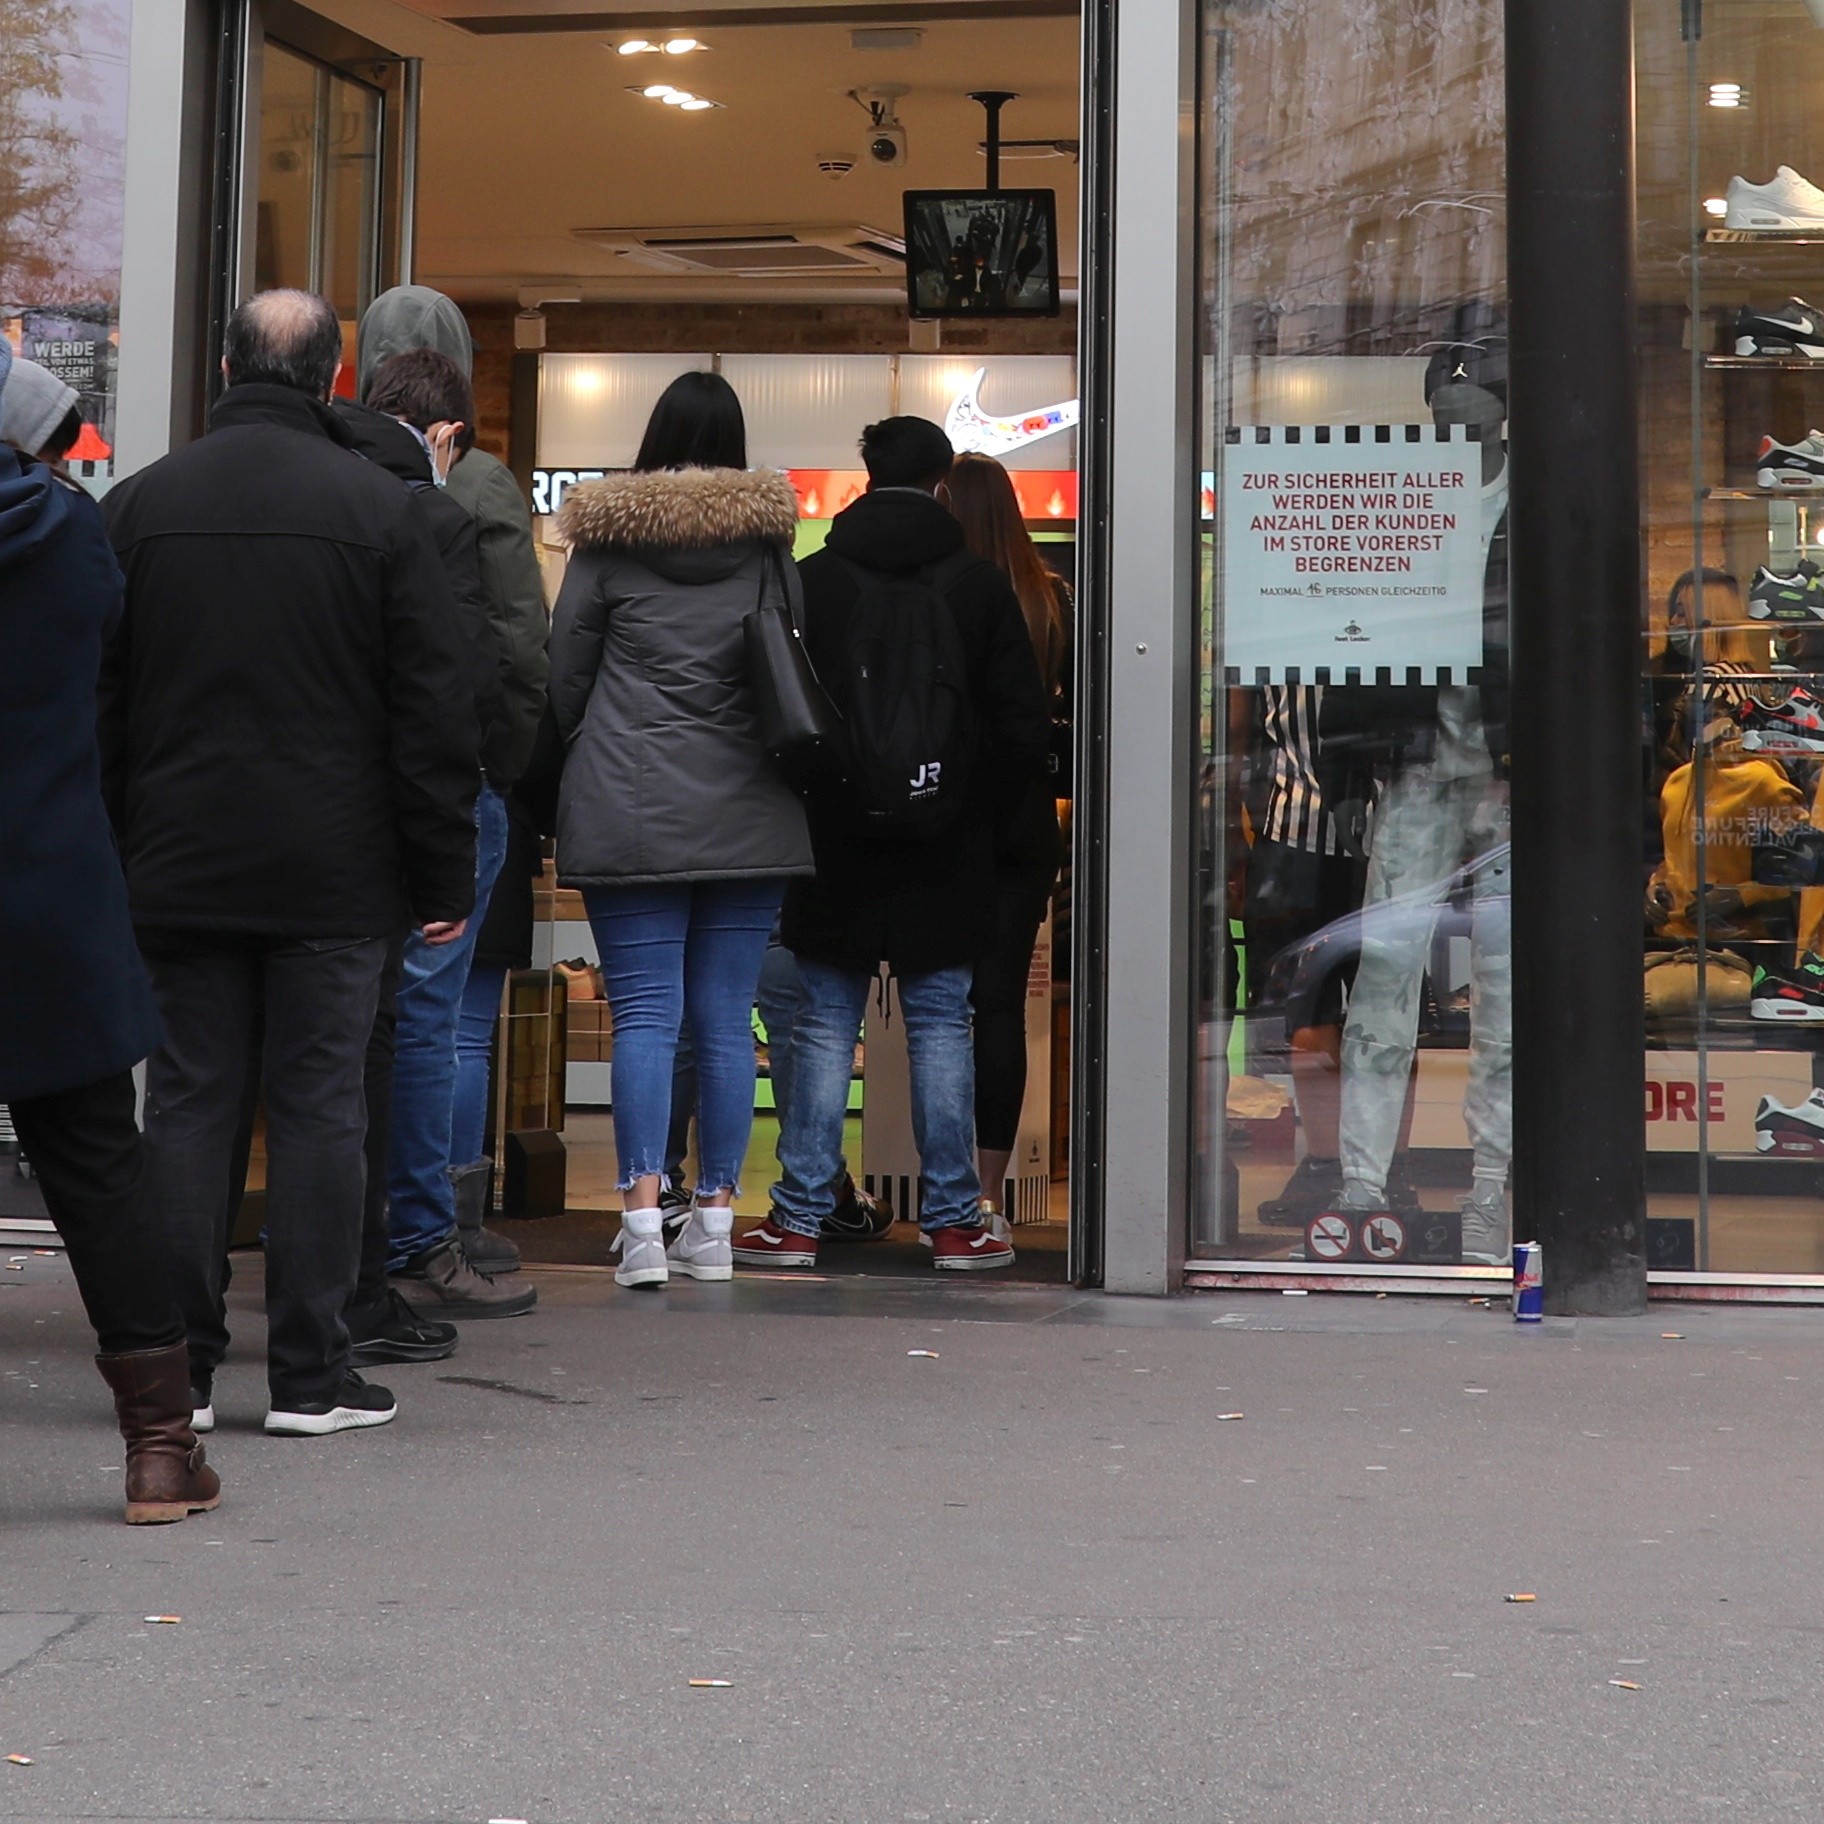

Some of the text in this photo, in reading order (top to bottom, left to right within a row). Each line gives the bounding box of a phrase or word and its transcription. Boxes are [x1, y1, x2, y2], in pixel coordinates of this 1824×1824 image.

[34, 341, 95, 357] WERDE
[49, 366, 94, 378] OSSEM!
[1242, 472, 1464, 489] ZUR SICHERHEIT ALLER
[1273, 494, 1433, 509] WERDEN WIR DIE
[1250, 514, 1456, 531] ANZAHL DER KUNDEN
[1264, 535, 1443, 551] IM STORE VORERST
[1295, 557, 1410, 572] BEGRENZEN
[1261, 586, 1303, 596] MAXIMAL
[1326, 586, 1379, 596] PERSONEN
[1381, 586, 1447, 596] GLEICHZEITIG
[909, 762, 941, 788] JR
